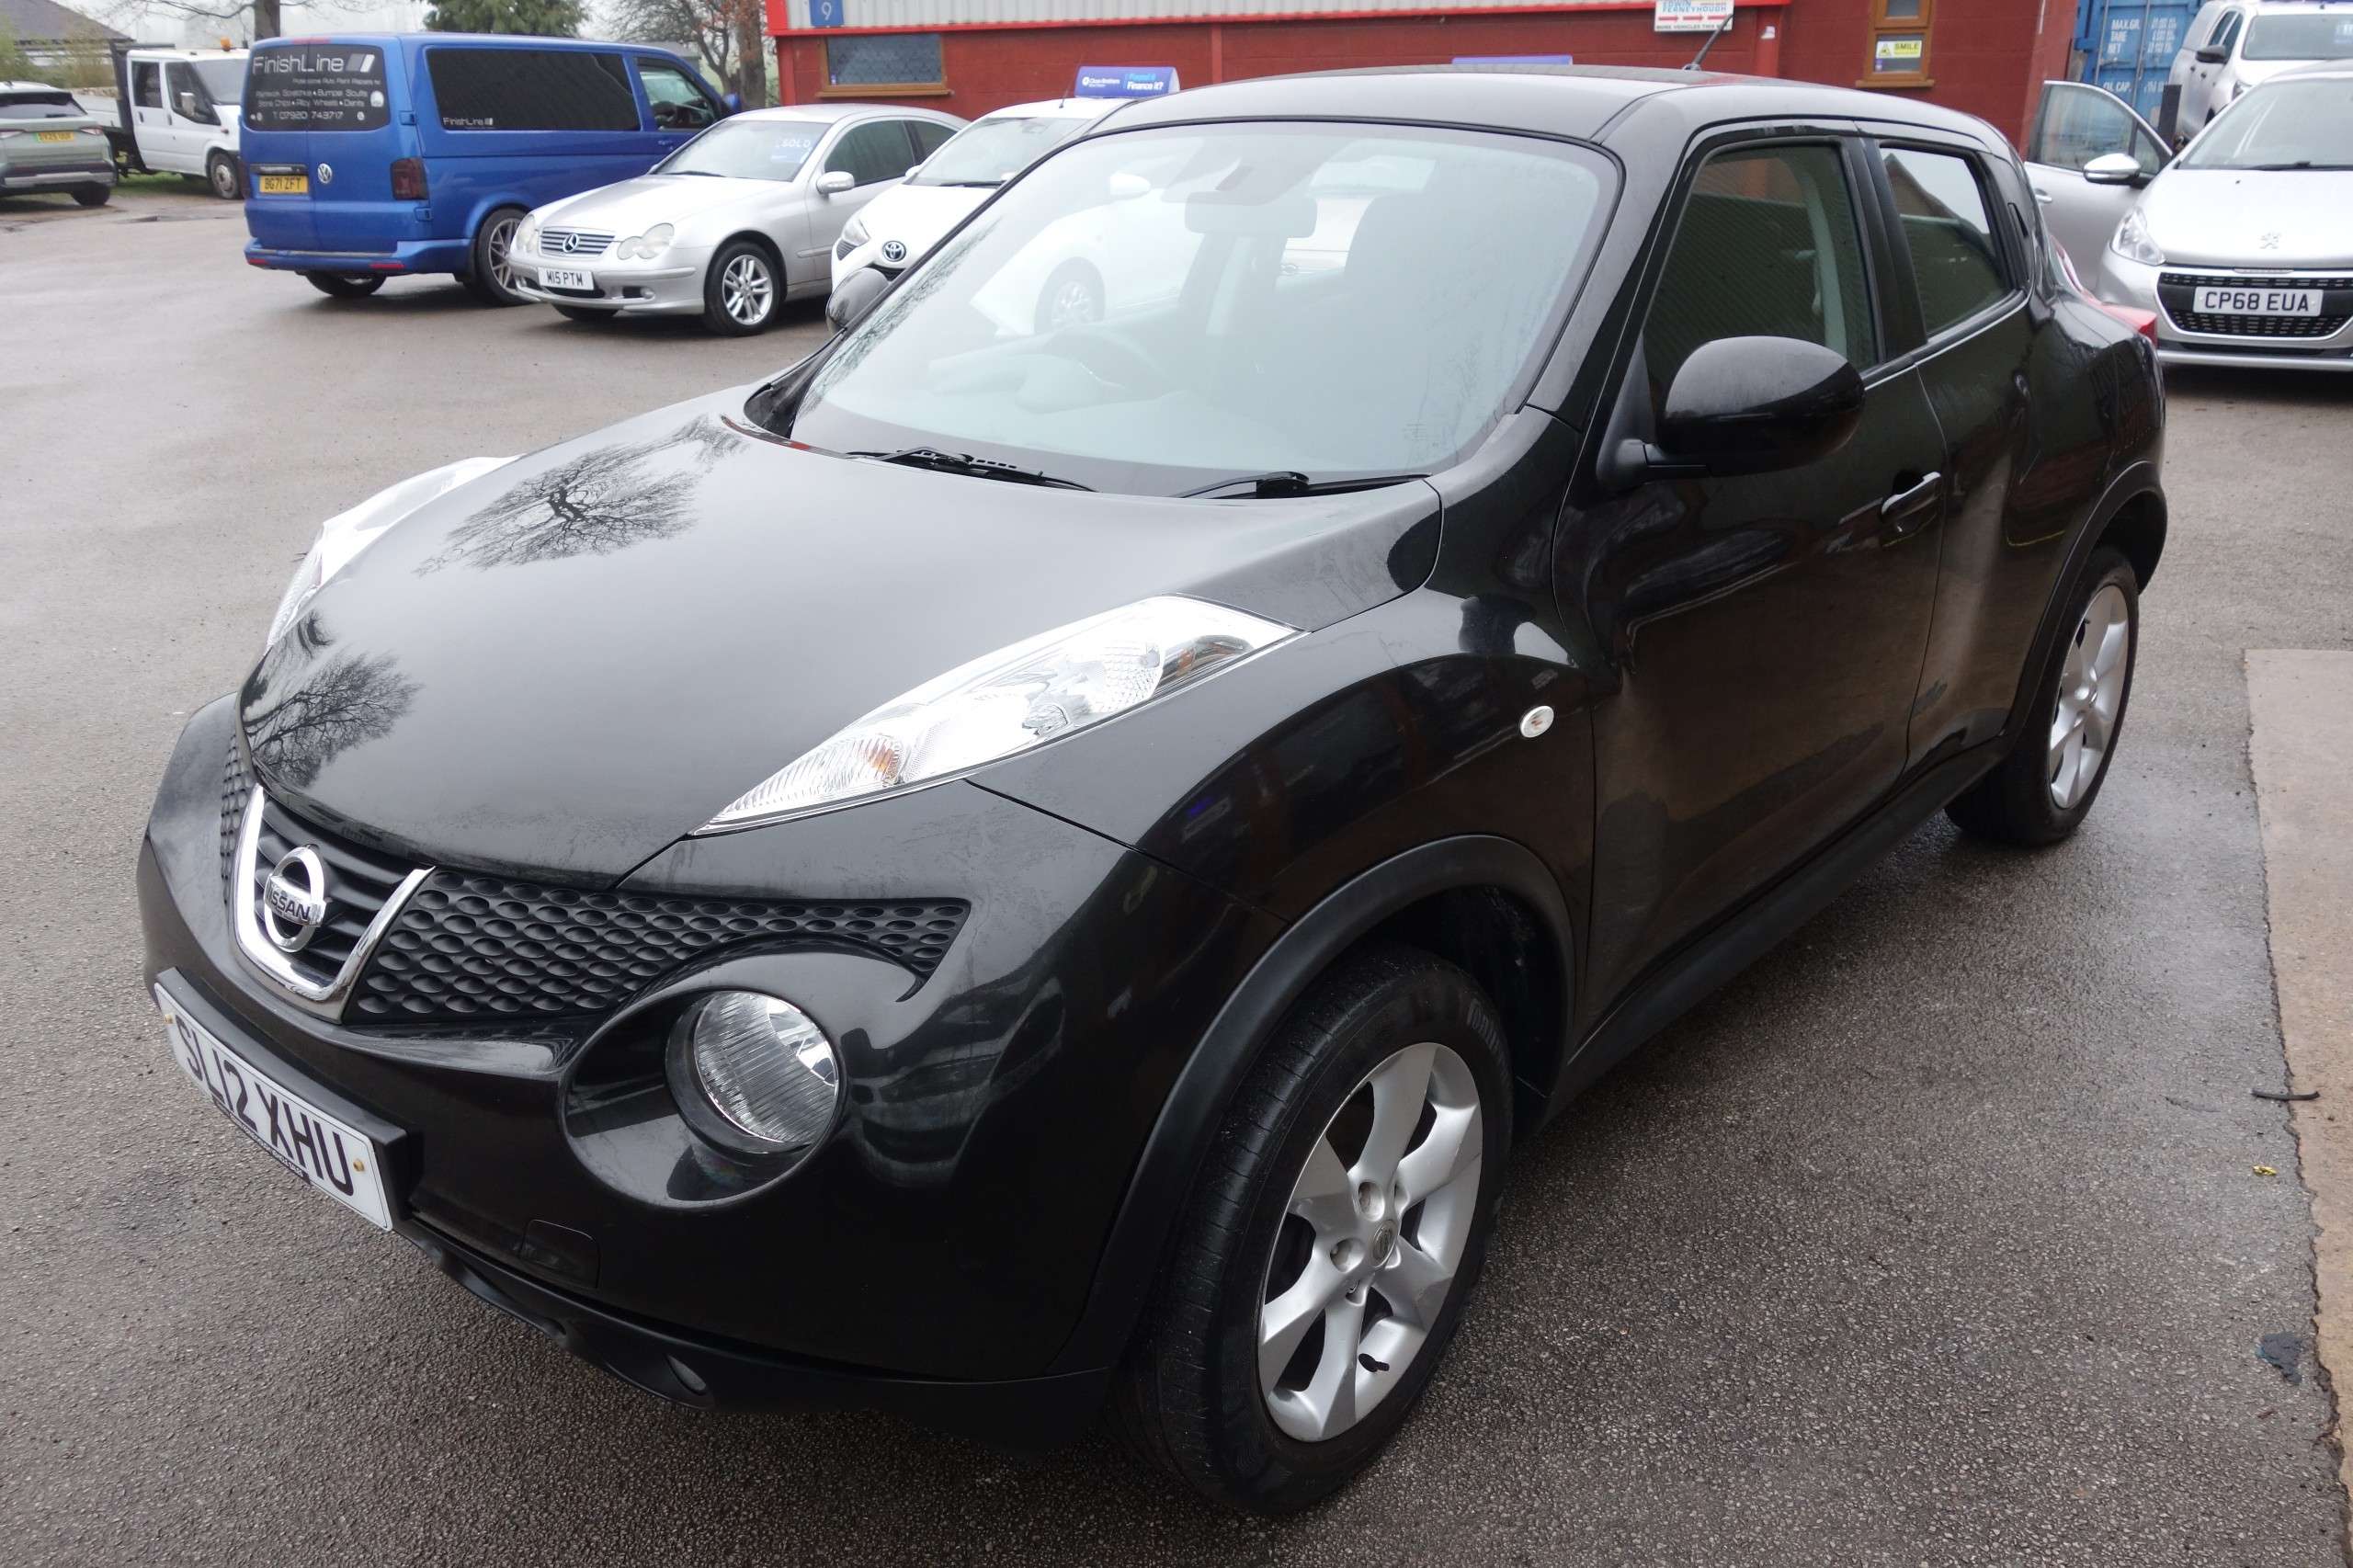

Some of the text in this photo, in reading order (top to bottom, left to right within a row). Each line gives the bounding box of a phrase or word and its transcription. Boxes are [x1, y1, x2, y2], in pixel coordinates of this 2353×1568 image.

[822, 2, 832, 20] 9
[252, 53, 345, 74] FinishLine
[2206, 291, 2309, 312] CP68 EUA
[175, 1014, 258, 1133] SL12
[255, 1082, 355, 1197] XHU
